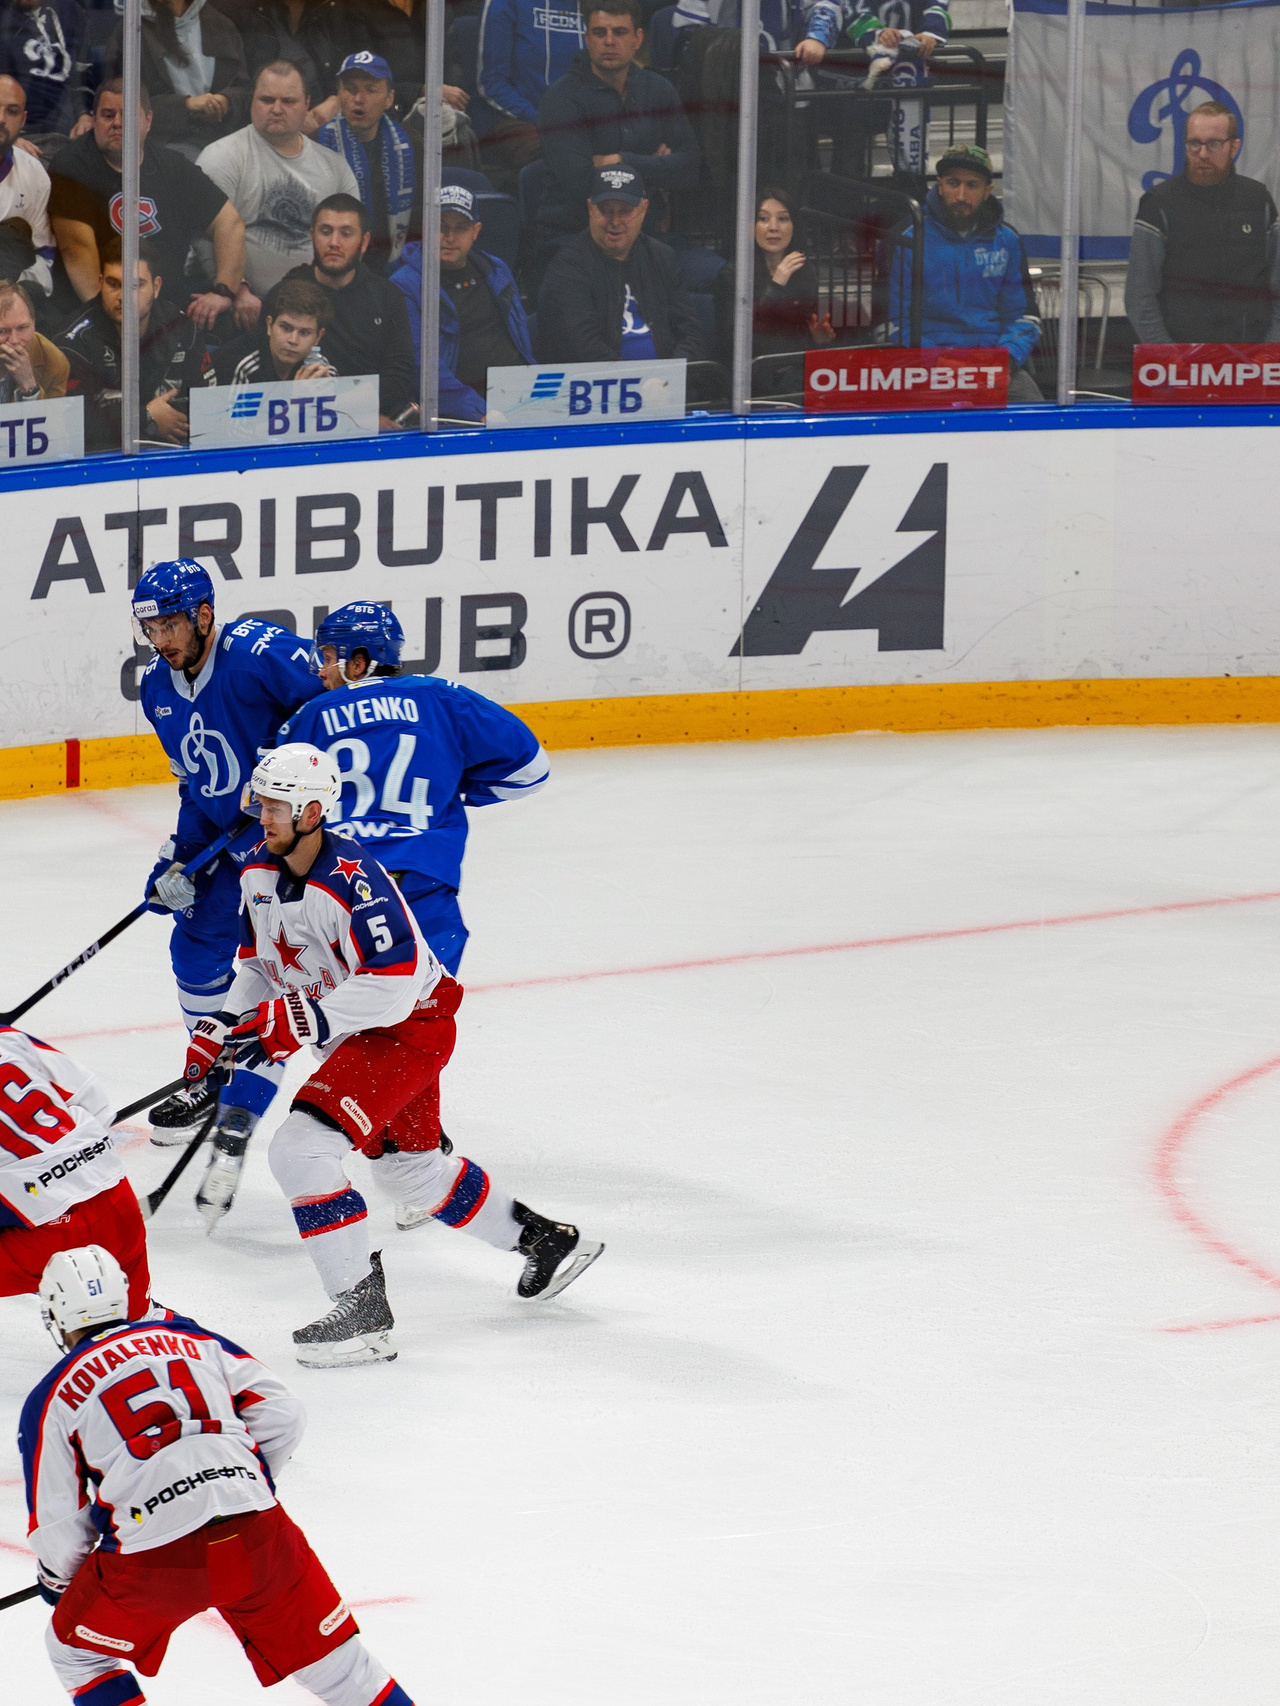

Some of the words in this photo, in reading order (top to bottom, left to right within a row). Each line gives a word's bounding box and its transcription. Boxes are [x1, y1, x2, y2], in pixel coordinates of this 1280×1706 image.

[568, 377, 643, 416] ВТБ
[809, 366, 1003, 392] OLIMPBET
[267, 395, 338, 435] ВТБ
[31, 470, 728, 600] ATRIBUTIKA
[135, 604, 157, 615] согаз
[354, 605, 375, 614] ВТБ
[321, 696, 420, 736] ILYENKO
[366, 914, 394, 953] 5
[343, 1099, 371, 1133] OLIMPBET
[37, 1135, 114, 1188] РОСНЕФТ
[87, 1278, 103, 1297] 51
[57, 1334, 202, 1412] KOVALENKO
[98, 1358, 222, 1462] 51
[144, 1466, 258, 1516] РОСНЕФТЬ
